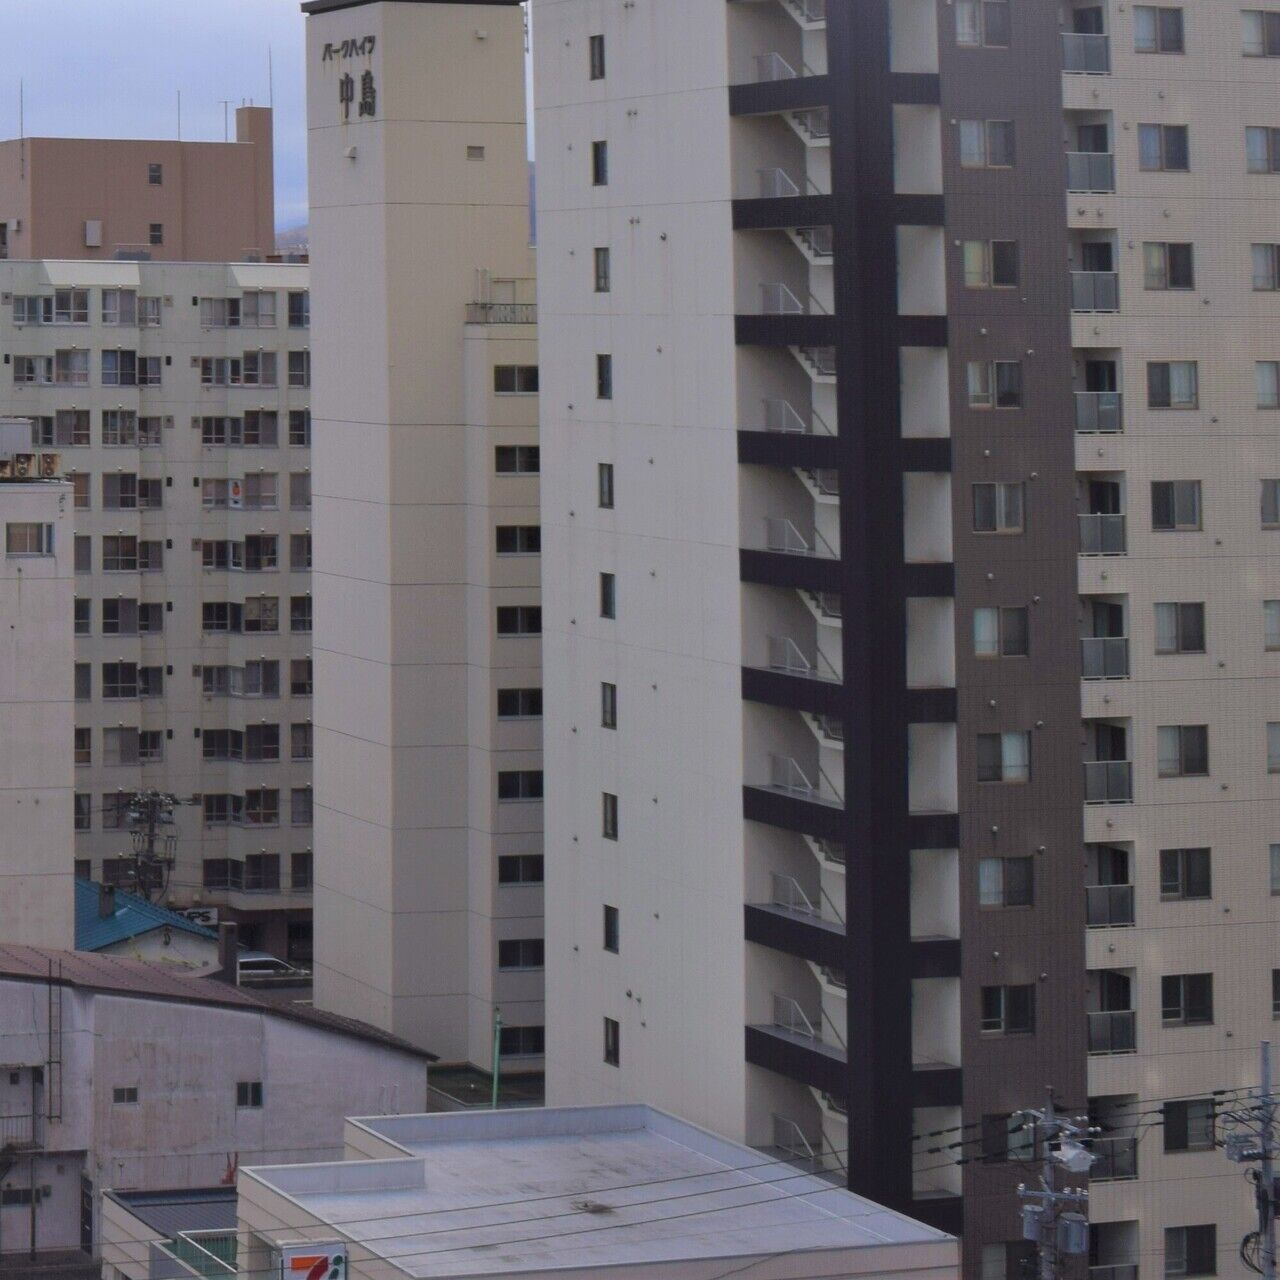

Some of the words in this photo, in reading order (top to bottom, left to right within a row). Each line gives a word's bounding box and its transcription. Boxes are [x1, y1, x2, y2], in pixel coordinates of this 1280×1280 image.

[322, 35, 376, 61] パークハイツ
[339, 69, 377, 119] 中島
